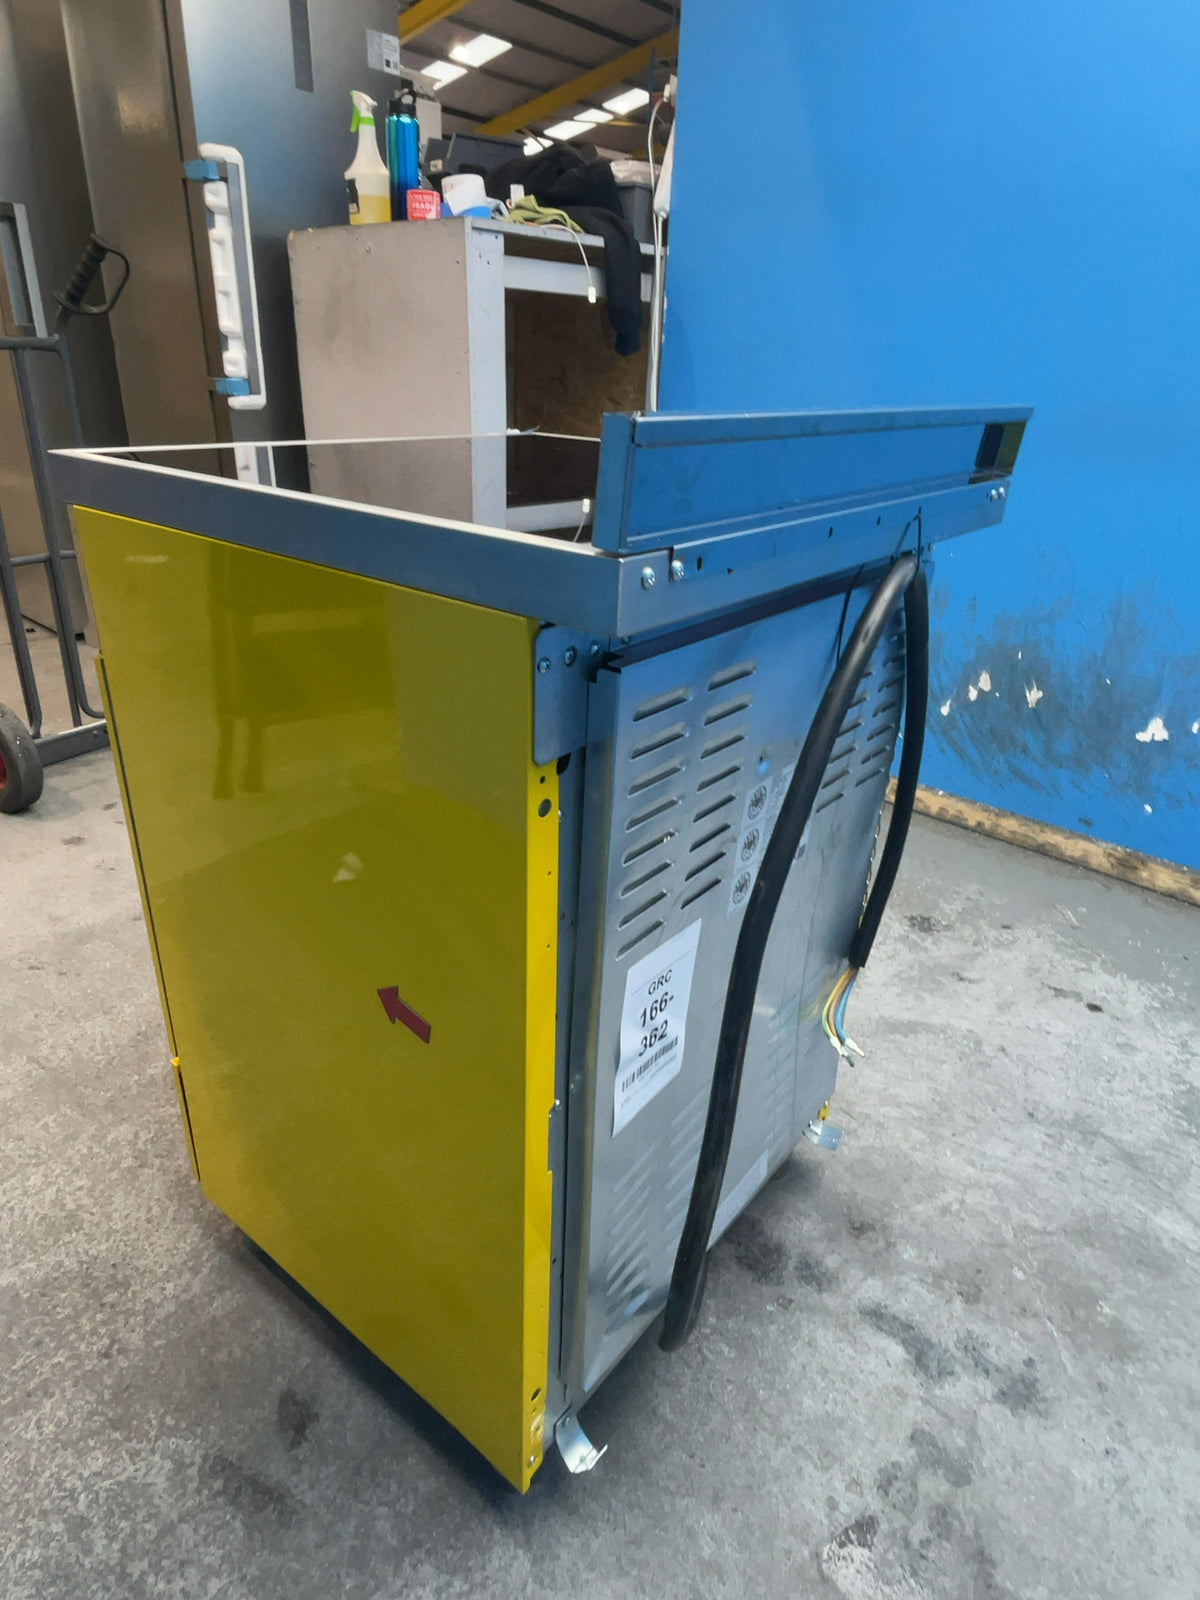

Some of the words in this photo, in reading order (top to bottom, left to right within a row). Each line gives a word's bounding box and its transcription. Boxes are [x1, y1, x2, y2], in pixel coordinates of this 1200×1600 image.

[648, 969, 672, 996] GRC
[640, 991, 675, 1028] 166-
[638, 1019, 669, 1057] 362
